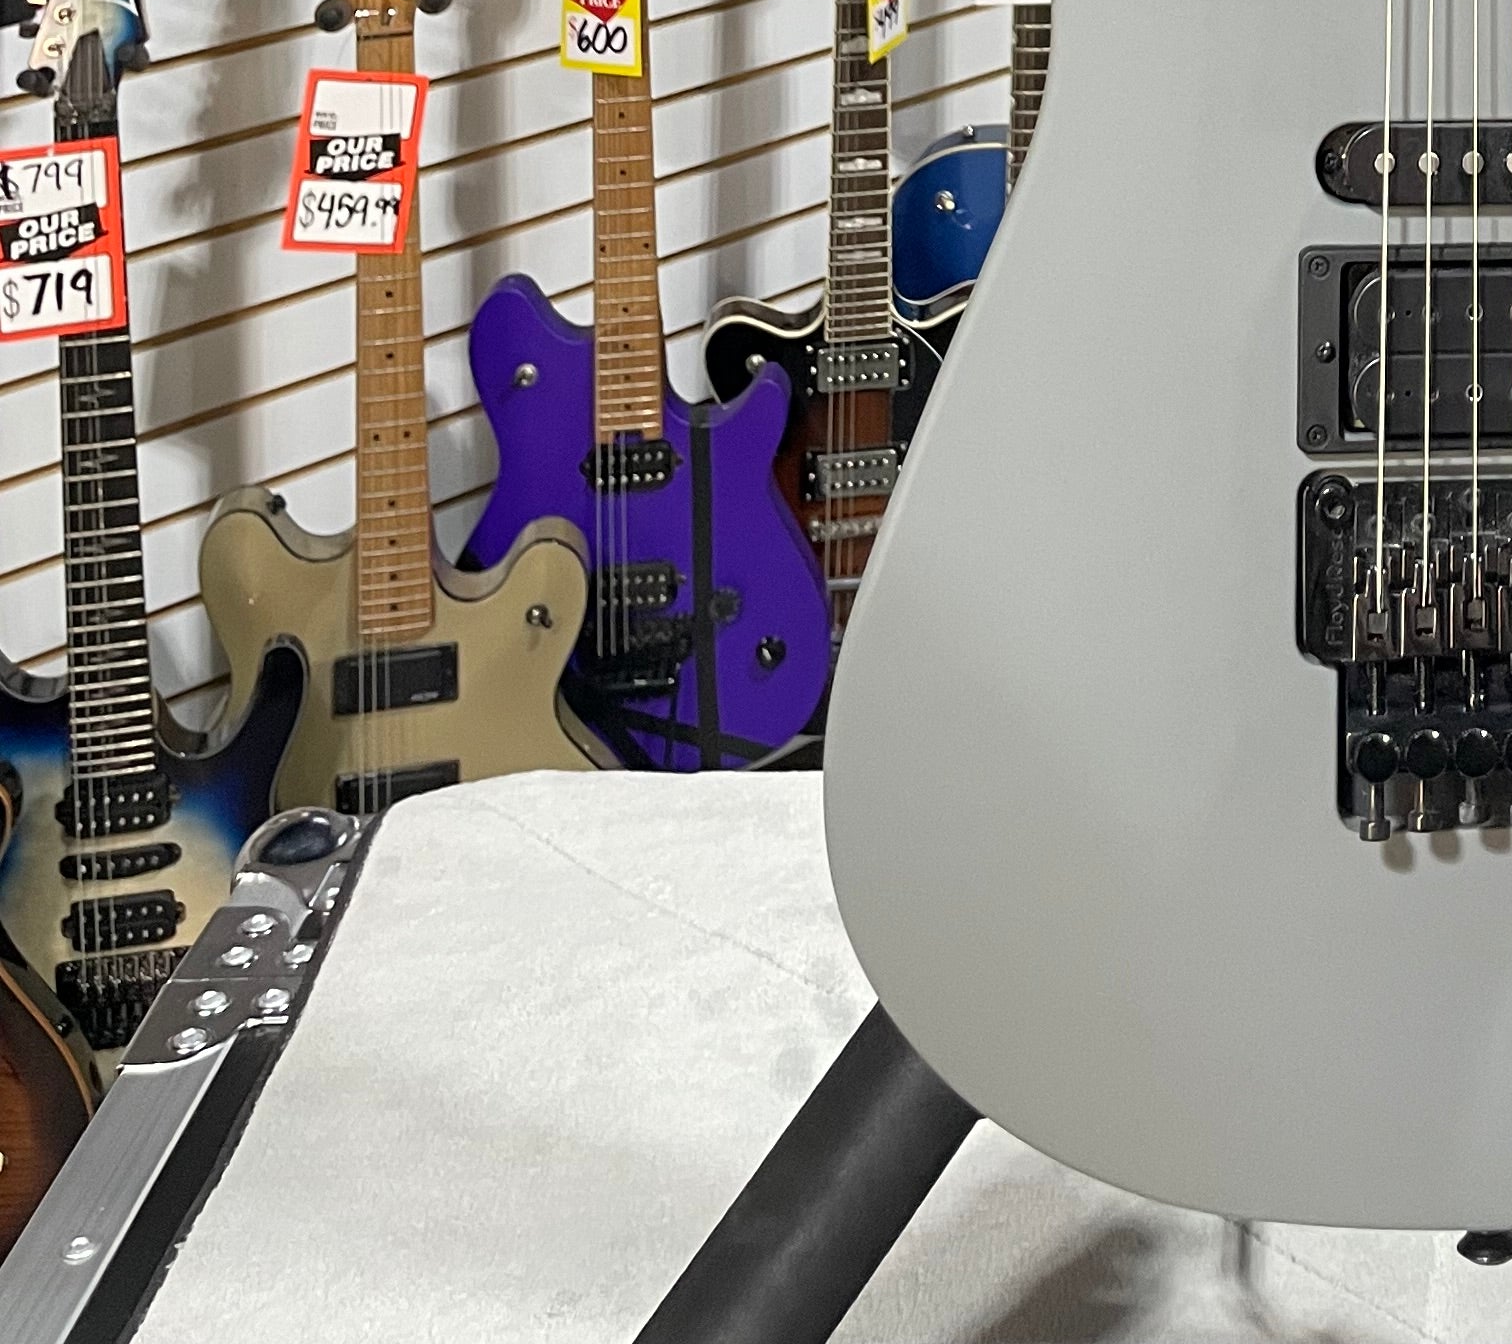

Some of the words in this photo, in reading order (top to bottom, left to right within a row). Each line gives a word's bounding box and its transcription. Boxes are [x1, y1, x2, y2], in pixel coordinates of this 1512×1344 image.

[327, 136, 383, 156] OUR
[315, 151, 396, 175] PRICE
[18, 209, 80, 238] OUR
[10, 222, 95, 260] PRICE
[3, 268, 94, 322] $719
